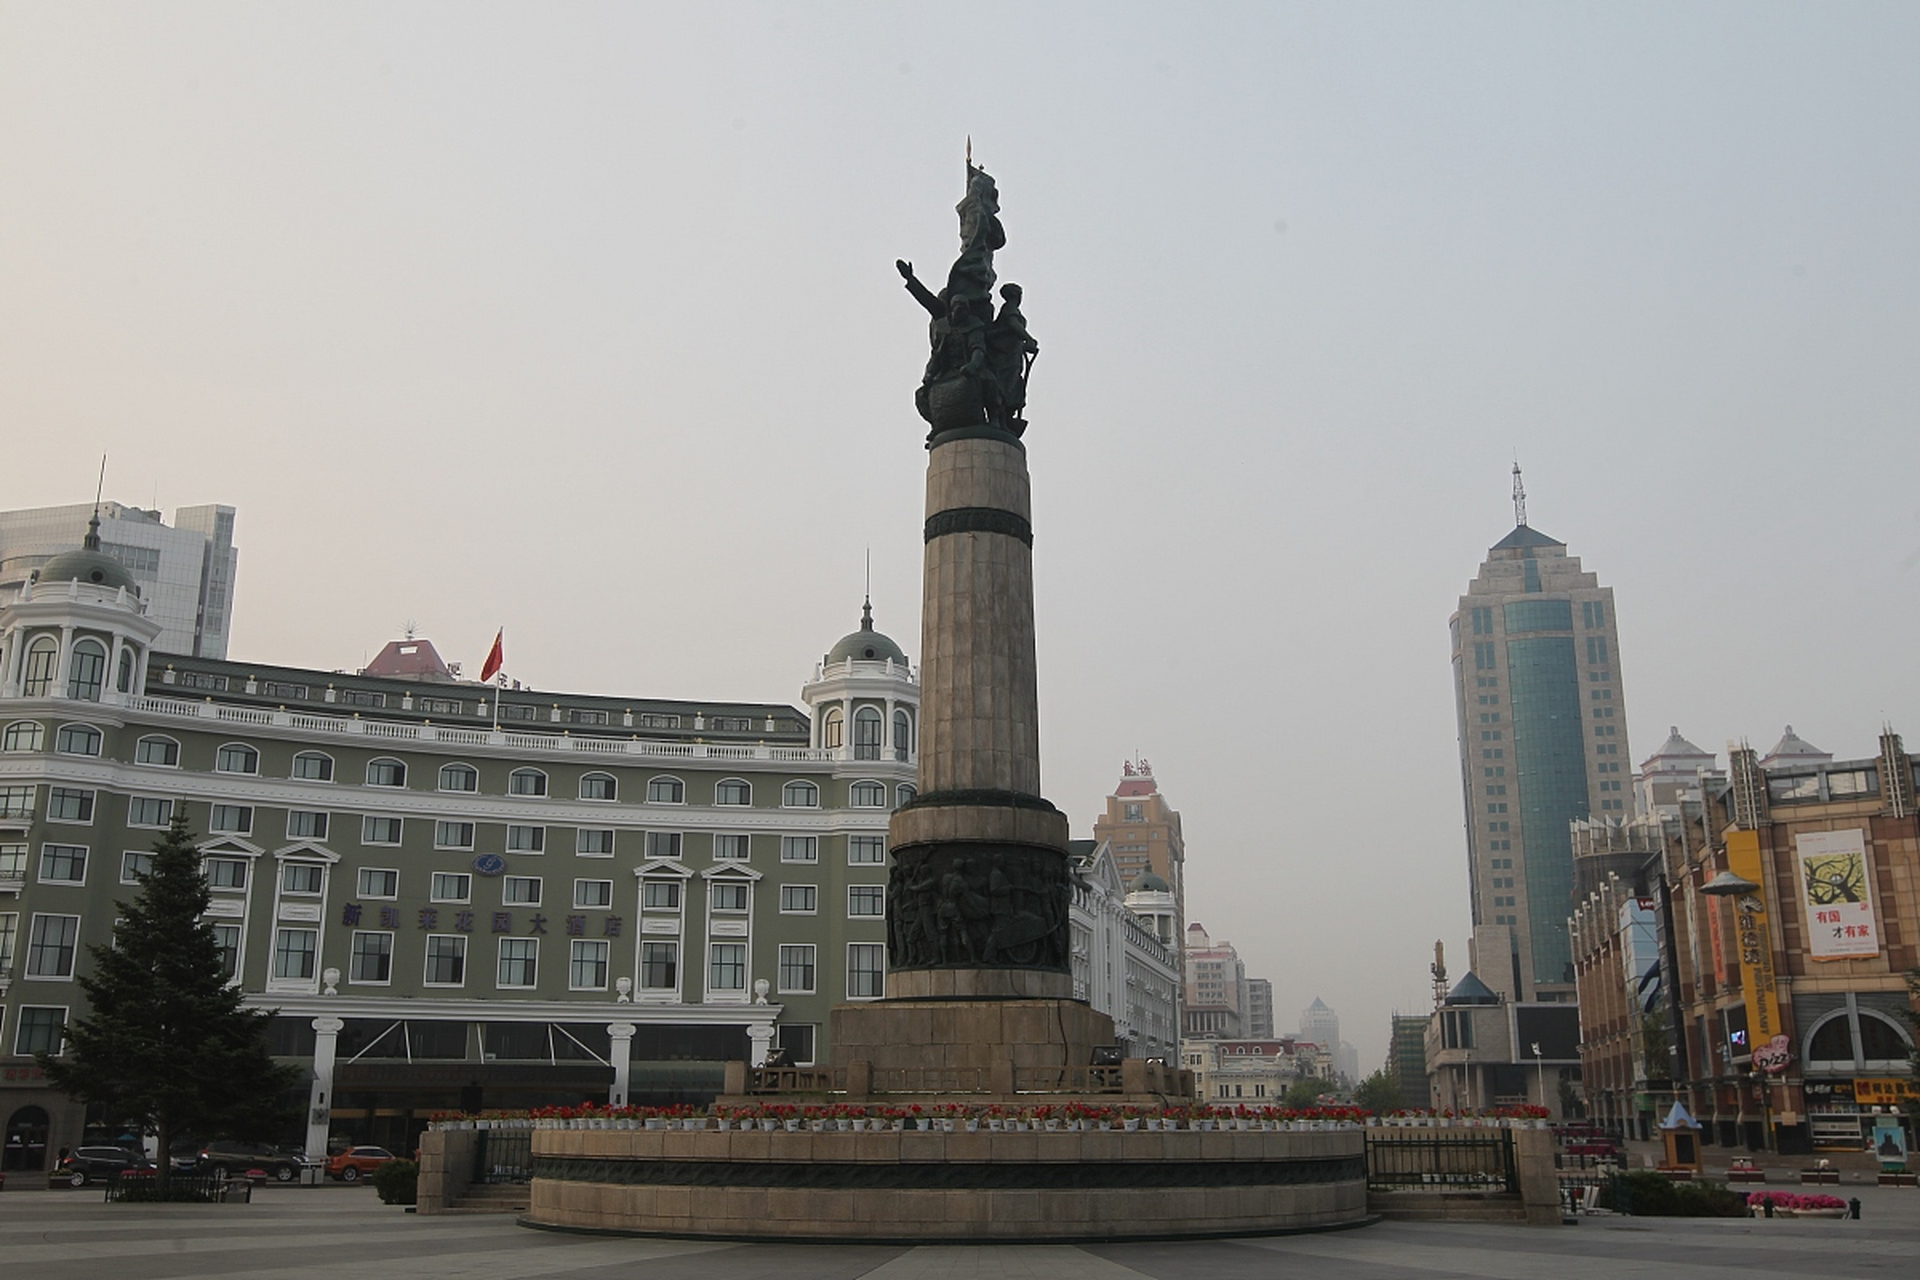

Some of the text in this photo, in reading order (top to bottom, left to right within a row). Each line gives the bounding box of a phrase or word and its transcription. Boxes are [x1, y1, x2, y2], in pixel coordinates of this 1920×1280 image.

[342, 902, 624, 938] 新凯莱花园大酒店
[1815, 910, 1841, 924] 有国
[1832, 924, 1870, 939] 才有家
